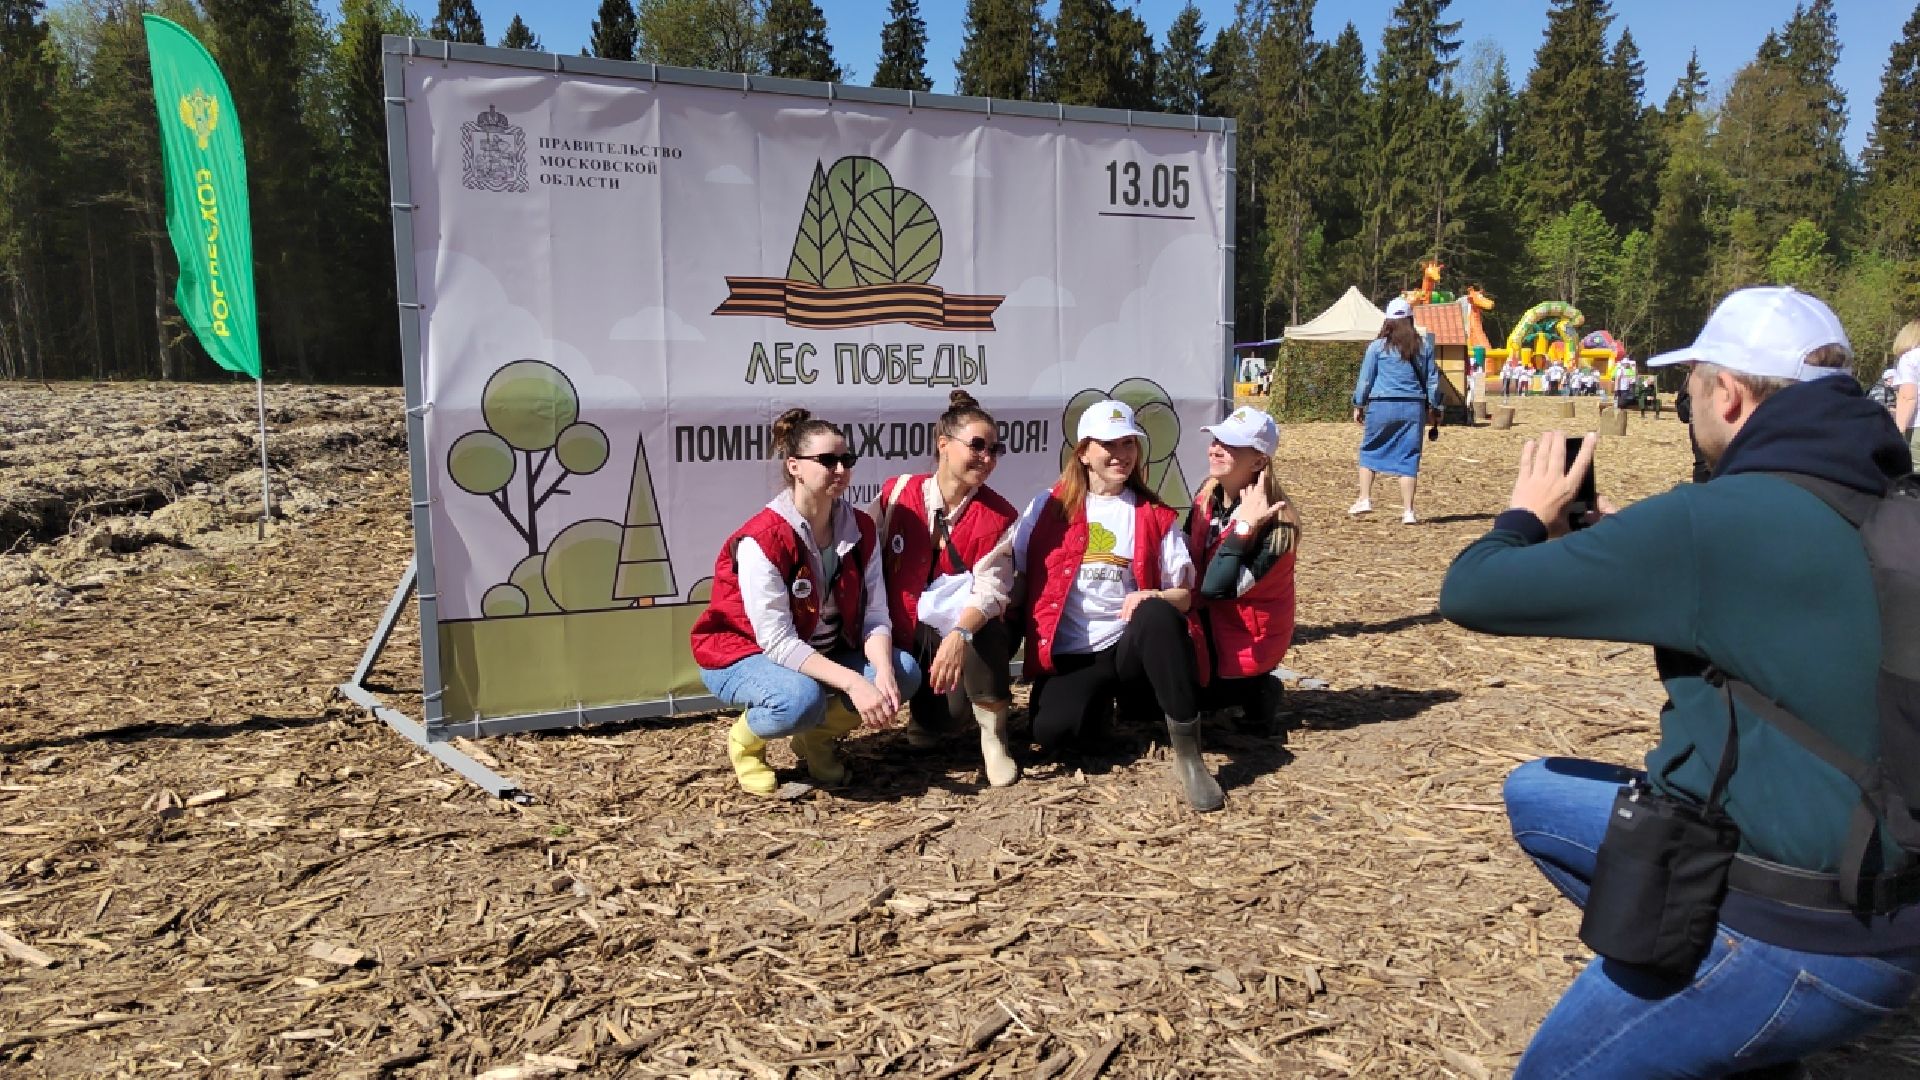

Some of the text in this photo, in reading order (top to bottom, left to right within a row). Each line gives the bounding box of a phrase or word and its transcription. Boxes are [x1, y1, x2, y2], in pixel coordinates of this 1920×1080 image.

[539, 137, 683, 160] ПРАВИТЕЛЬСТВО
[540, 155, 658, 175] МОСКОВСКОЙ
[540, 173, 620, 190] ОБЛАСТИ
[1105, 160, 1190, 209] 13.05
[196, 168, 231, 337] РОСЛЕСХОЗ
[744, 342, 988, 388] ЛЕС ПОБЕДЫ
[675, 419, 1049, 463] ПОМНИ АЖДОГ РОЯ!
